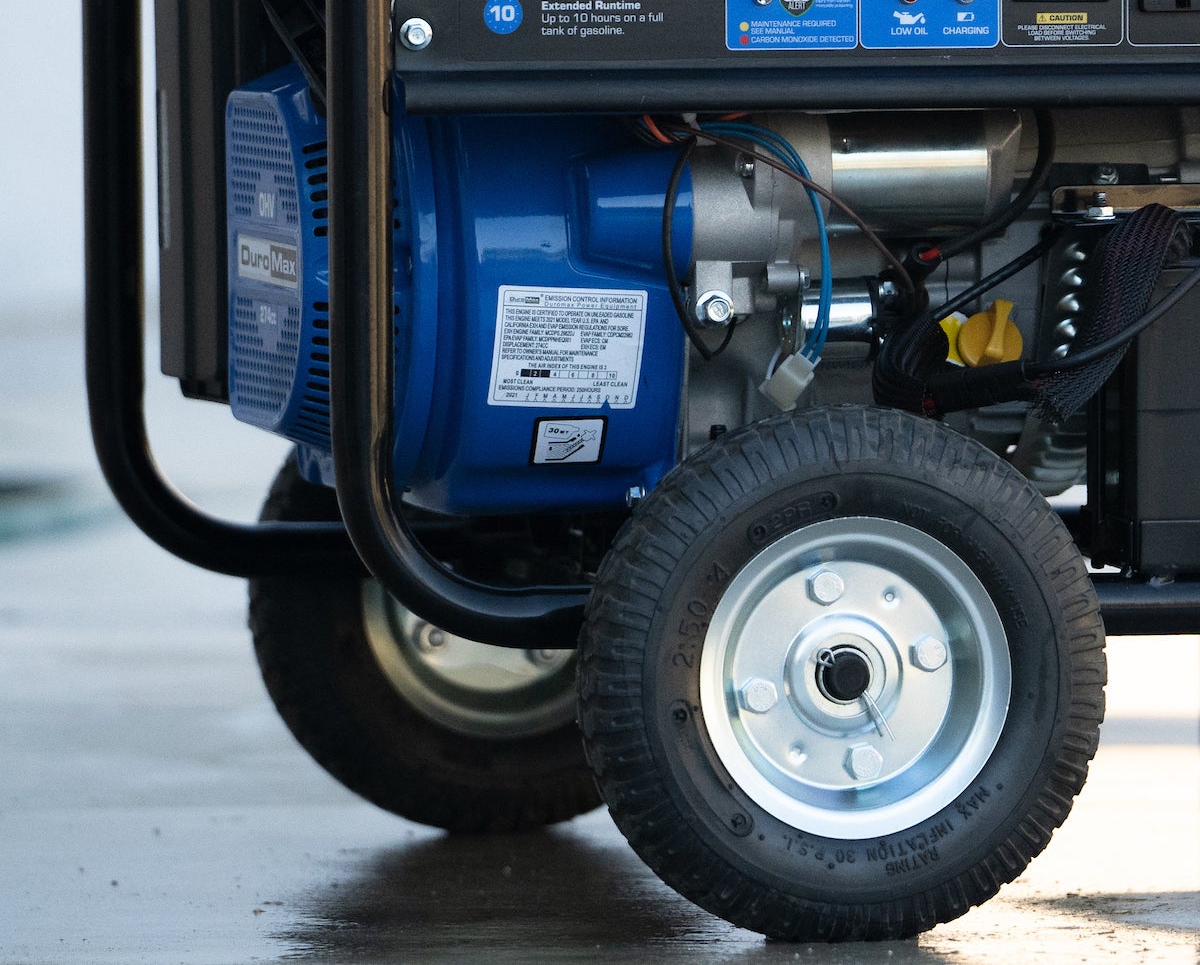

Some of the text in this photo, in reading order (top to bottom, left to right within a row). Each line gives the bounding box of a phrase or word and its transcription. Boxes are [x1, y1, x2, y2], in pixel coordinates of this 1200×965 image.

[541, 0, 641, 10] Extended Runtime
[788, 1, 806, 10] ALERT
[489, 5, 515, 22] 10
[541, 13, 556, 25] Up
[558, 14, 570, 23] to
[573, 13, 588, 23] 10
[591, 13, 621, 23] hours
[648, 12, 664, 22] full
[541, 25, 625, 37] tank of gasoline.
[891, 27, 928, 35] LOW OIL
[943, 27, 989, 35] CHARGING
[258, 192, 275, 218] OHV
